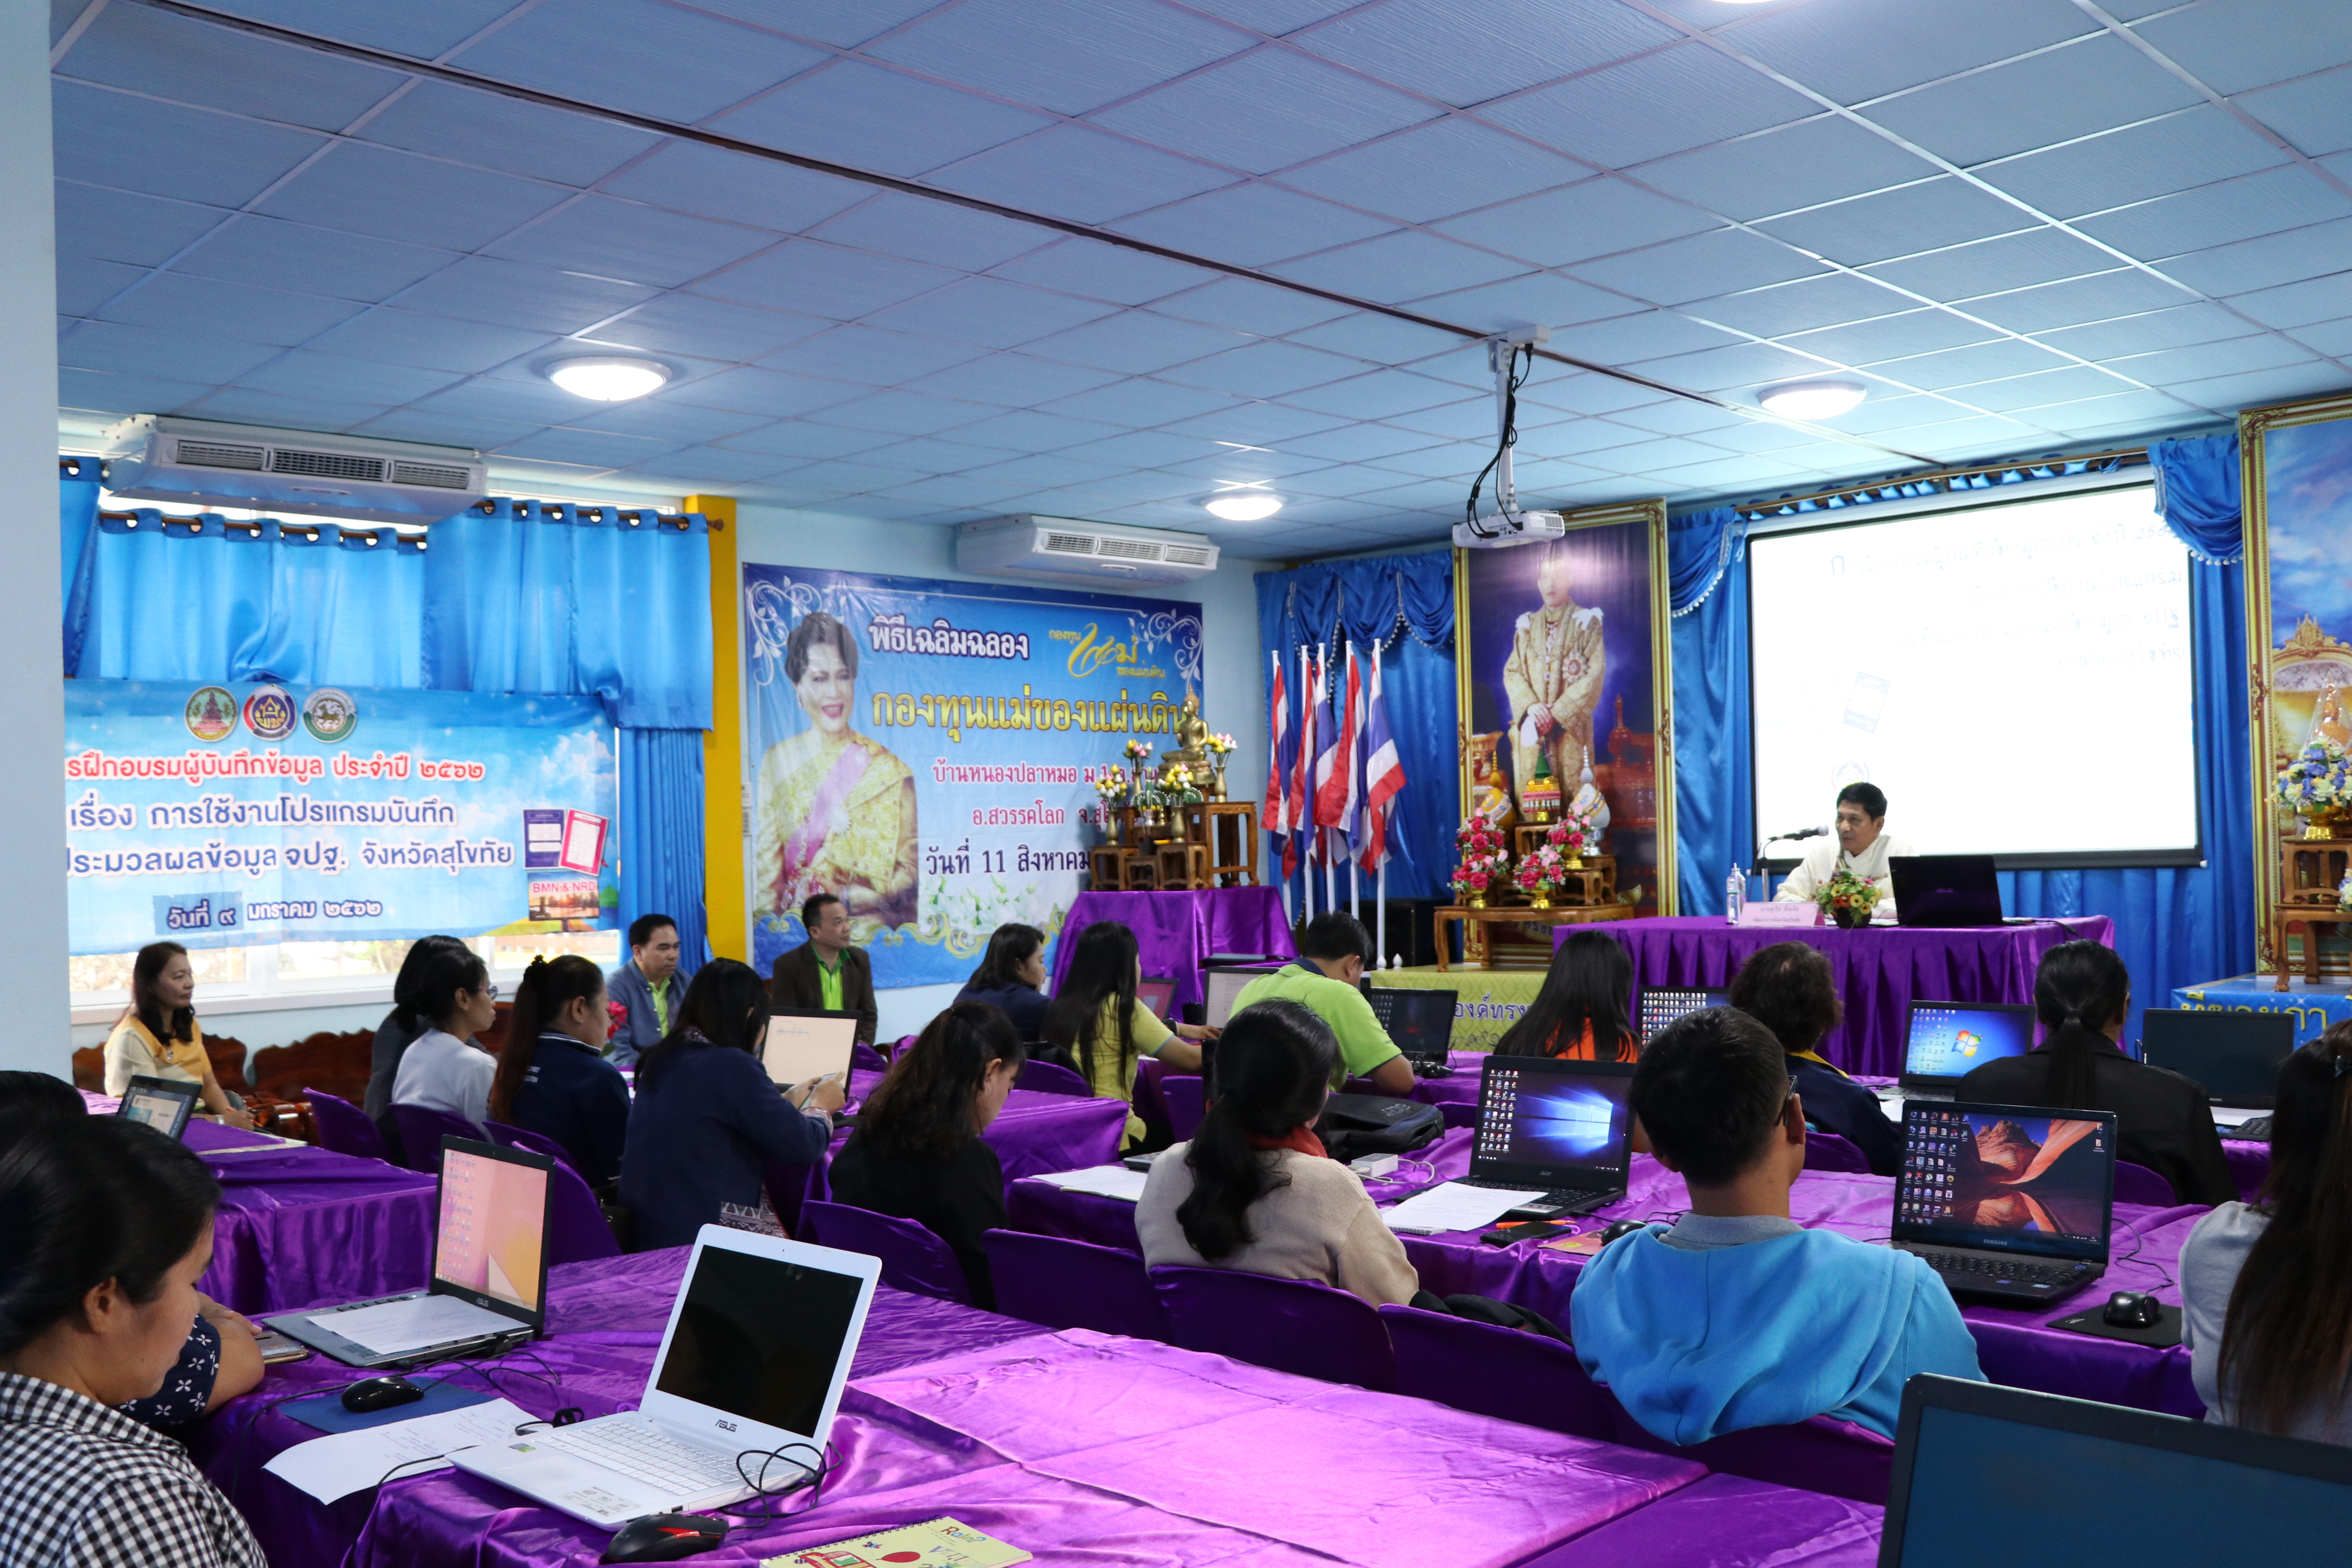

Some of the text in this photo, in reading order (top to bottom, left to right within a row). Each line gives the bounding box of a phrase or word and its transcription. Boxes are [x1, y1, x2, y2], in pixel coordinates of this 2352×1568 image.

[869, 614, 1029, 660] พิธีเฉลิมฉลอง
[1049, 630, 1082, 645] กองทุน
[872, 684, 1187, 742] กองทุนแม่ของแผ่นดิน
[334, 754, 408, 778] ประจำปี
[420, 763, 483, 779] ๒๕๖๒
[933, 759, 1077, 783] บ้านหนองปลาหมอ
[72, 793, 453, 826] เรื่อง การใช้งานโปรแกรมบันทึก
[973, 800, 1064, 826] อ.สวรรคโลก
[286, 841, 346, 871] จปฐ.
[364, 841, 511, 873] จังหวัดสุโขทัย
[926, 838, 1091, 875] วันที่ 11 สิงหาคม
[533, 881, 597, 893] BMN & NRD
[168, 899, 381, 929] วันที่ ๙ มกราคม ๒๕๖๒
[476, 1298, 489, 1307] ASUS
[715, 1419, 737, 1432] ASUS
